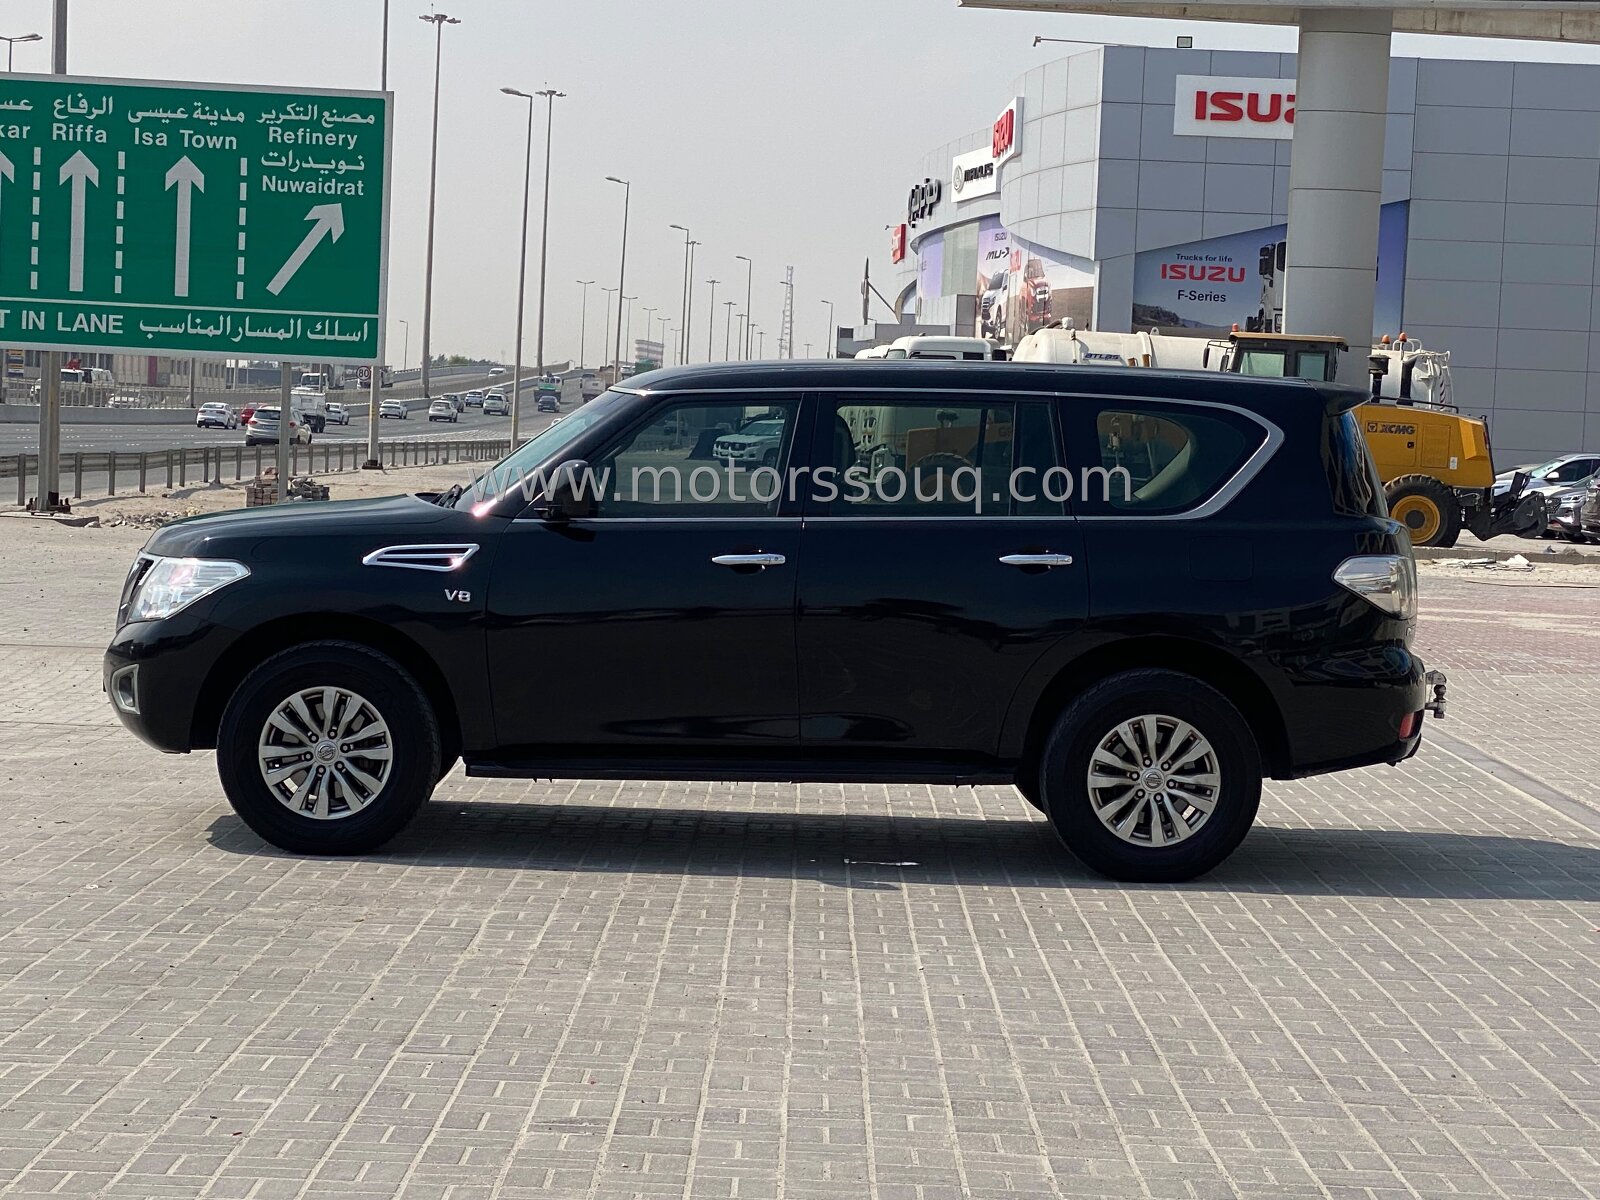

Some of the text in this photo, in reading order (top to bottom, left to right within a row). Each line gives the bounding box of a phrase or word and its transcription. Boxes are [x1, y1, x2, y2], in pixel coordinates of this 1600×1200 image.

[53, 92, 113, 120] الرفاع
[127, 101, 245, 126] مدينة عيسى
[256, 103, 375, 128] مصنع التكرير
[52, 122, 107, 143] Riffa
[134, 127, 237, 150] Isa Town
[268, 126, 358, 150] Refinery
[261, 149, 365, 174] نويدرات
[262, 175, 364, 196] Nuwaidrat
[1176, 253, 1233, 263] Trucks for life
[1160, 263, 1246, 283] ISUZU
[1177, 289, 1226, 302] F-Series
[21, 310, 45, 330] IN
[57, 312, 124, 334] LANE
[307, 320, 368, 342] اسلك
[359, 368, 370, 378] 80
[1380, 423, 1416, 435] XCMG
[444, 588, 471, 602] V8
